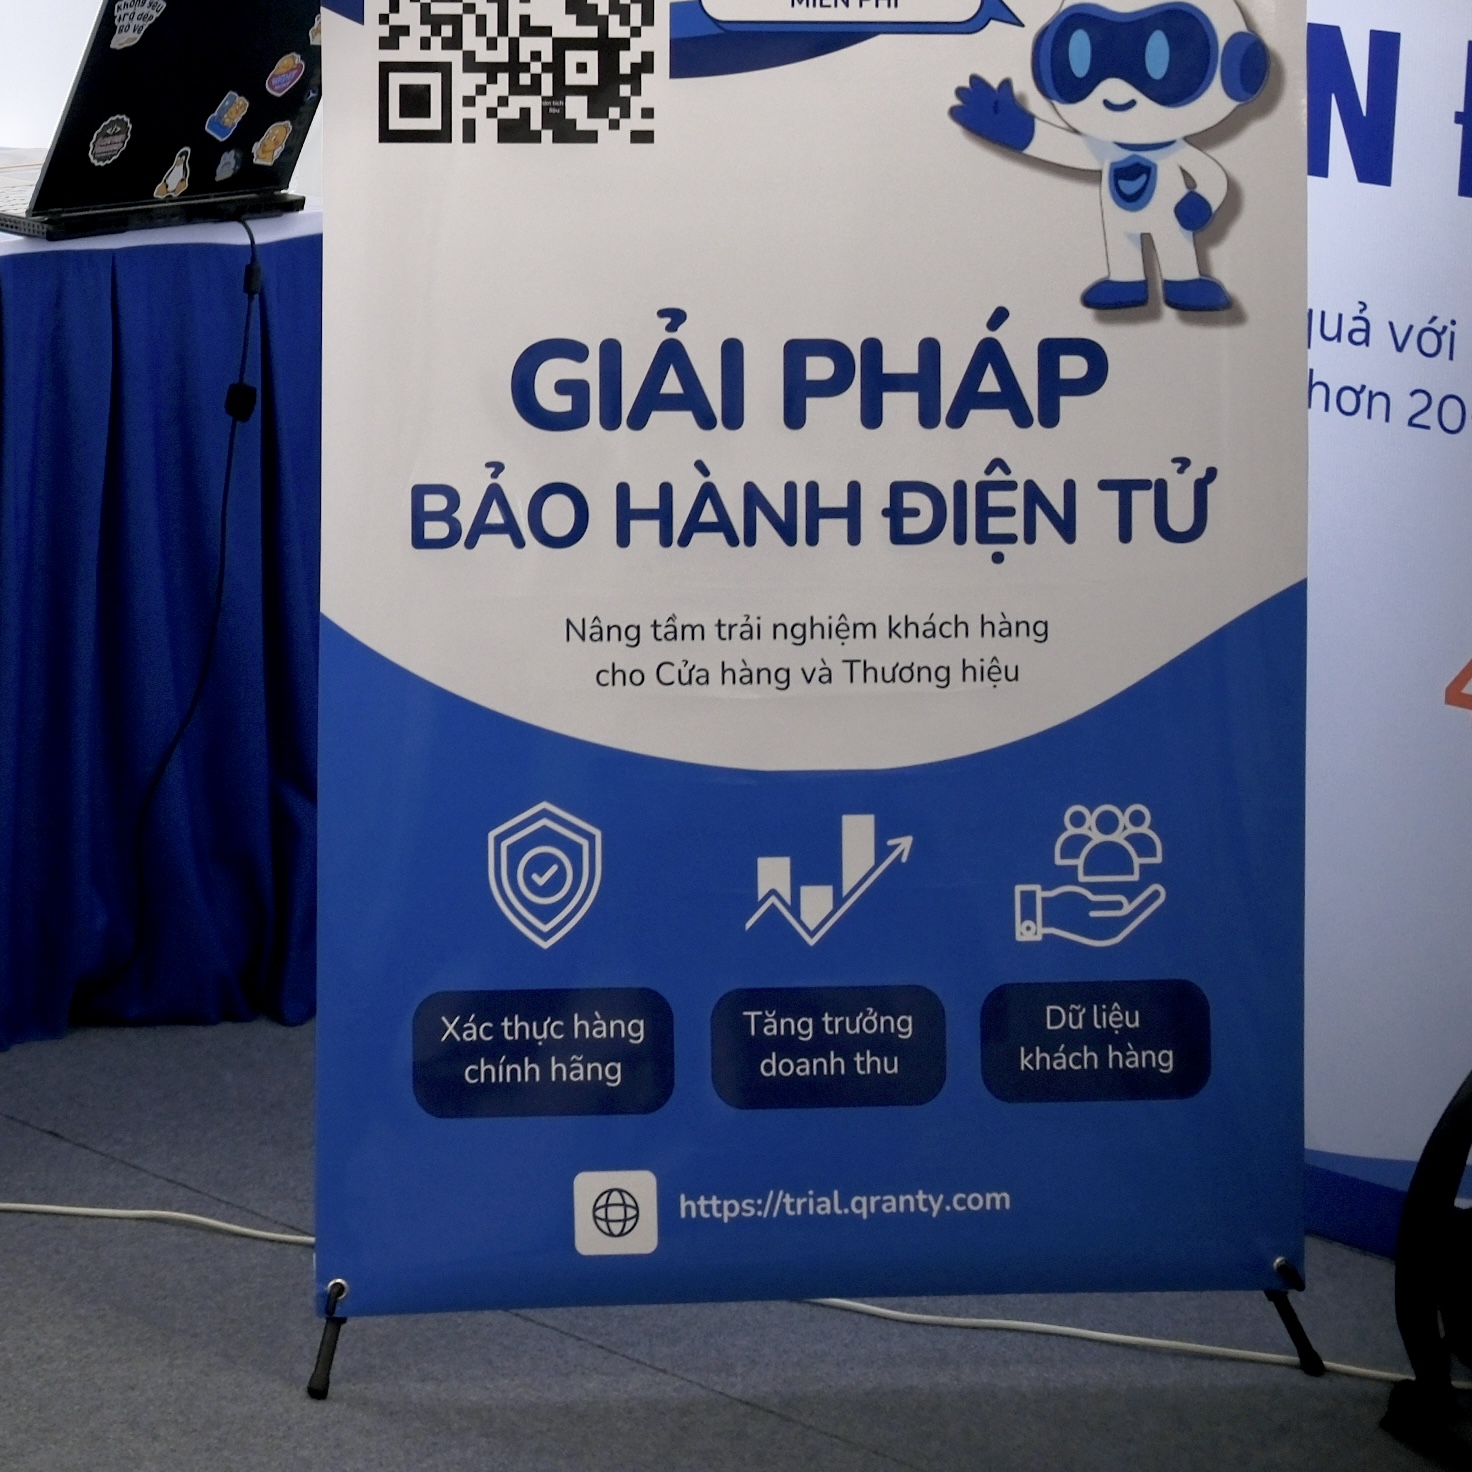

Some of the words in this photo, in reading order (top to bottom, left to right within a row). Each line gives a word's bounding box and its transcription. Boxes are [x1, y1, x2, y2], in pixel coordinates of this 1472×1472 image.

[1388, 315, 1457, 361] với
[510, 308, 744, 432] GIẢI
[783, 306, 1109, 432] PHÁP
[1308, 368, 1391, 423] hơn
[1407, 389, 1472, 435] 20
[410, 461, 589, 550] BẢO
[615, 459, 861, 548] HÀNH
[880, 457, 1076, 564] ĐIỆN
[1097, 456, 1218, 544] TỬ
[566, 615, 640, 648] Nâng
[650, 614, 704, 641] tầm
[714, 614, 760, 641] trải
[772, 613, 876, 646] nghiệm
[888, 613, 968, 639] khách
[980, 613, 1048, 643] hàng
[595, 661, 645, 686] cho
[655, 659, 709, 686] Cửa
[721, 658, 790, 691] hàng
[800, 658, 832, 684] và
[841, 659, 950, 689] Thương
[962, 655, 1018, 688] hiệu
[440, 1013, 493, 1042] Xác
[500, 1014, 564, 1045] thực
[573, 1010, 644, 1044] hàng
[742, 1009, 813, 1041] Tăng
[821, 1007, 912, 1039] trưởng
[1046, 1004, 1086, 1029] Dữ
[1093, 1002, 1139, 1034] liệu
[464, 1055, 540, 1083] chính
[551, 1054, 621, 1087] hãng
[760, 1050, 845, 1076] doanh
[853, 1049, 898, 1075] thu
[1020, 1043, 1098, 1071] khách
[1108, 1041, 1173, 1073] hàng
[679, 1189, 1010, 1223] https://trial.qranty.com
